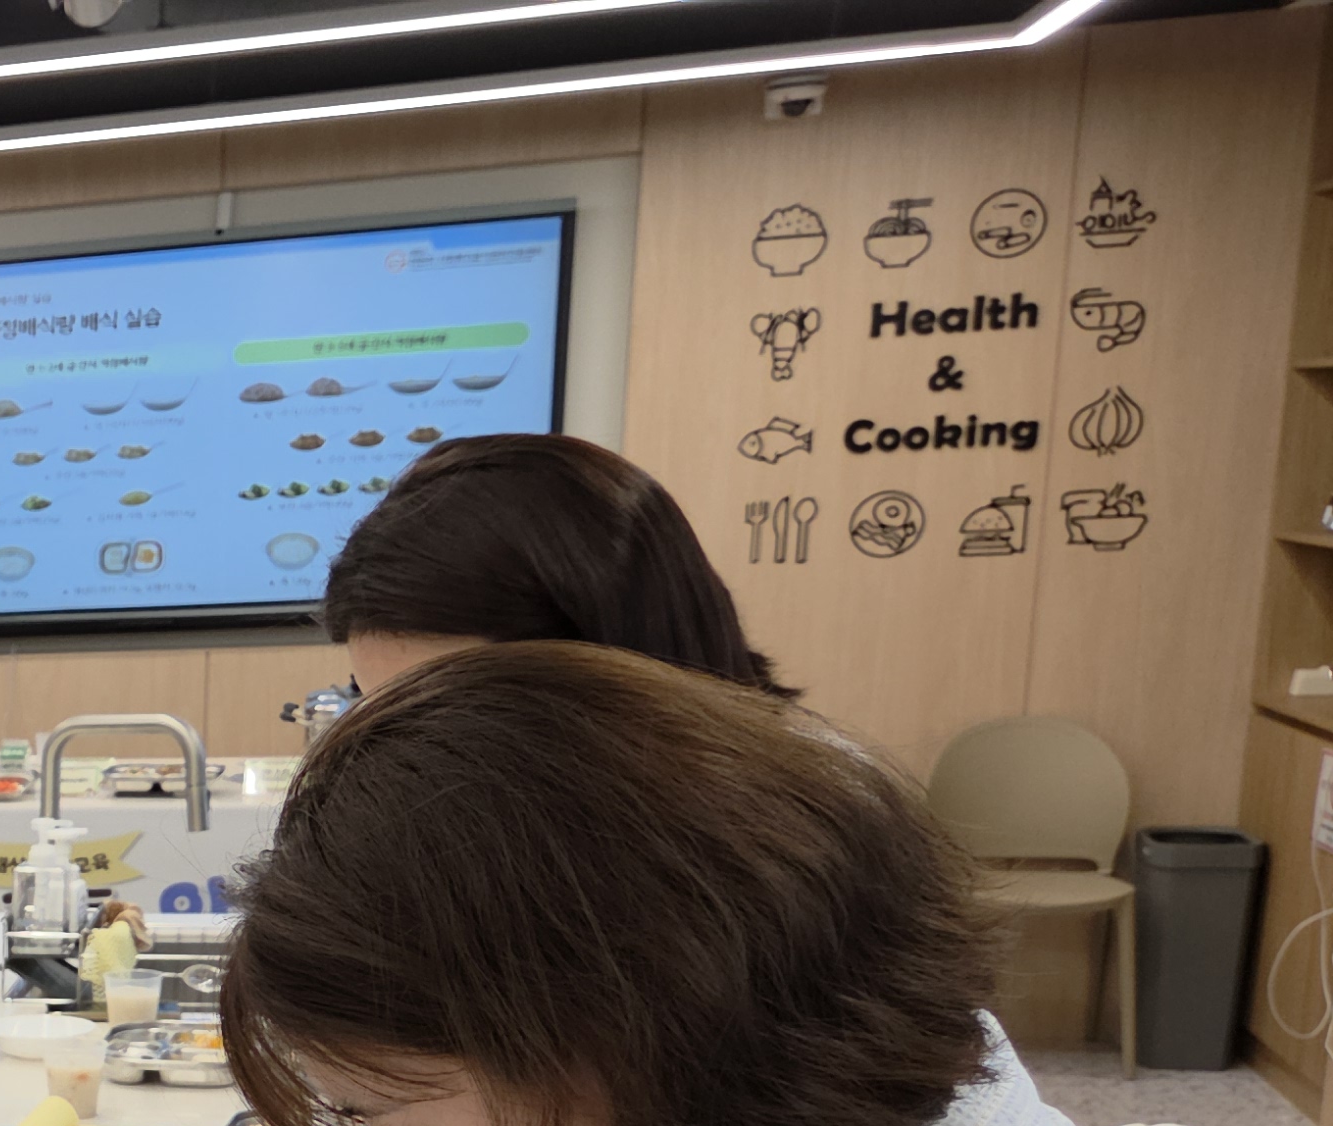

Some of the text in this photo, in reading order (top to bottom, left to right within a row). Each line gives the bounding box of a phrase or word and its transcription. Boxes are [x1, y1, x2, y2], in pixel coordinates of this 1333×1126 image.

[80, 310, 118, 332] 배식
[125, 307, 162, 328] 실습
[870, 292, 1039, 338] Health
[928, 355, 964, 392] &
[843, 414, 1040, 455] Cooking
